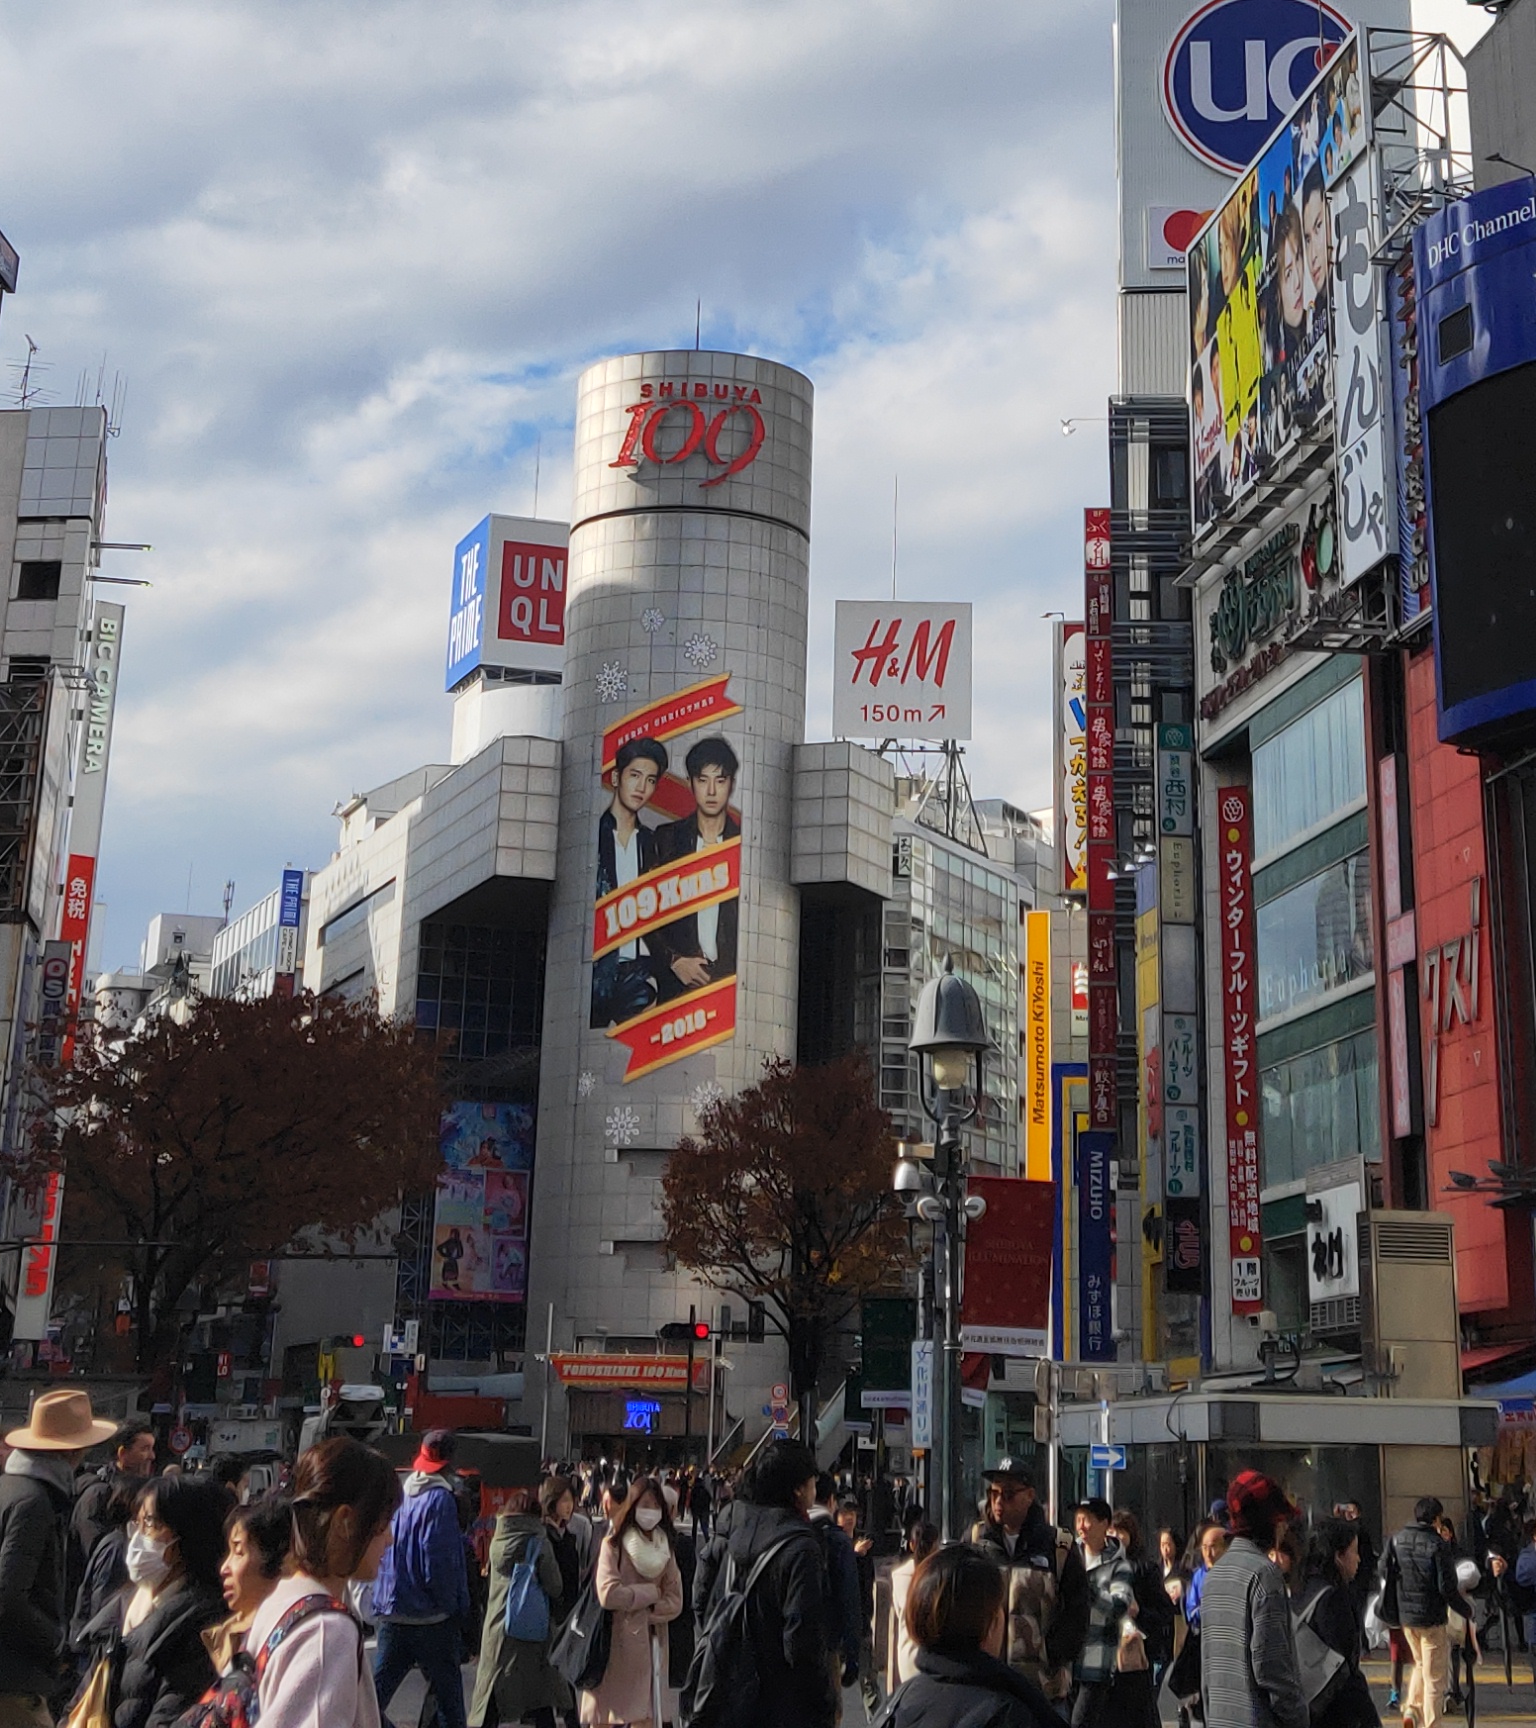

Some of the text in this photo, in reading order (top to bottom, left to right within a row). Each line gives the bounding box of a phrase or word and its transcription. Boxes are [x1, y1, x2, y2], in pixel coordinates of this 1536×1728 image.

[1427, 197, 1536, 271] DHC Channel
[640, 382, 763, 404] SHIBUYA
[1334, 176, 1386, 554] もんじゃ
[609, 399, 766, 489] 109
[460, 542, 482, 597] THE
[513, 553, 564, 591] UN
[449, 595, 482, 671] PRIME
[510, 596, 562, 635] QL
[851, 618, 957, 689] H&M
[83, 617, 118, 775] BIC CAMERA
[617, 695, 716, 747] MERRY CHRISTMAS
[860, 703, 923, 724] 150m
[68, 876, 88, 920] 免税
[1225, 849, 1250, 1105] ウィンターフルーツギフト
[1031, 1022, 1046, 1125] Matsumoto
[1090, 1150, 1104, 1220] MIZUHO
[1244, 1130, 1260, 1234] 無料配送地域
[1088, 1274, 1103, 1352] みずほ銀行
